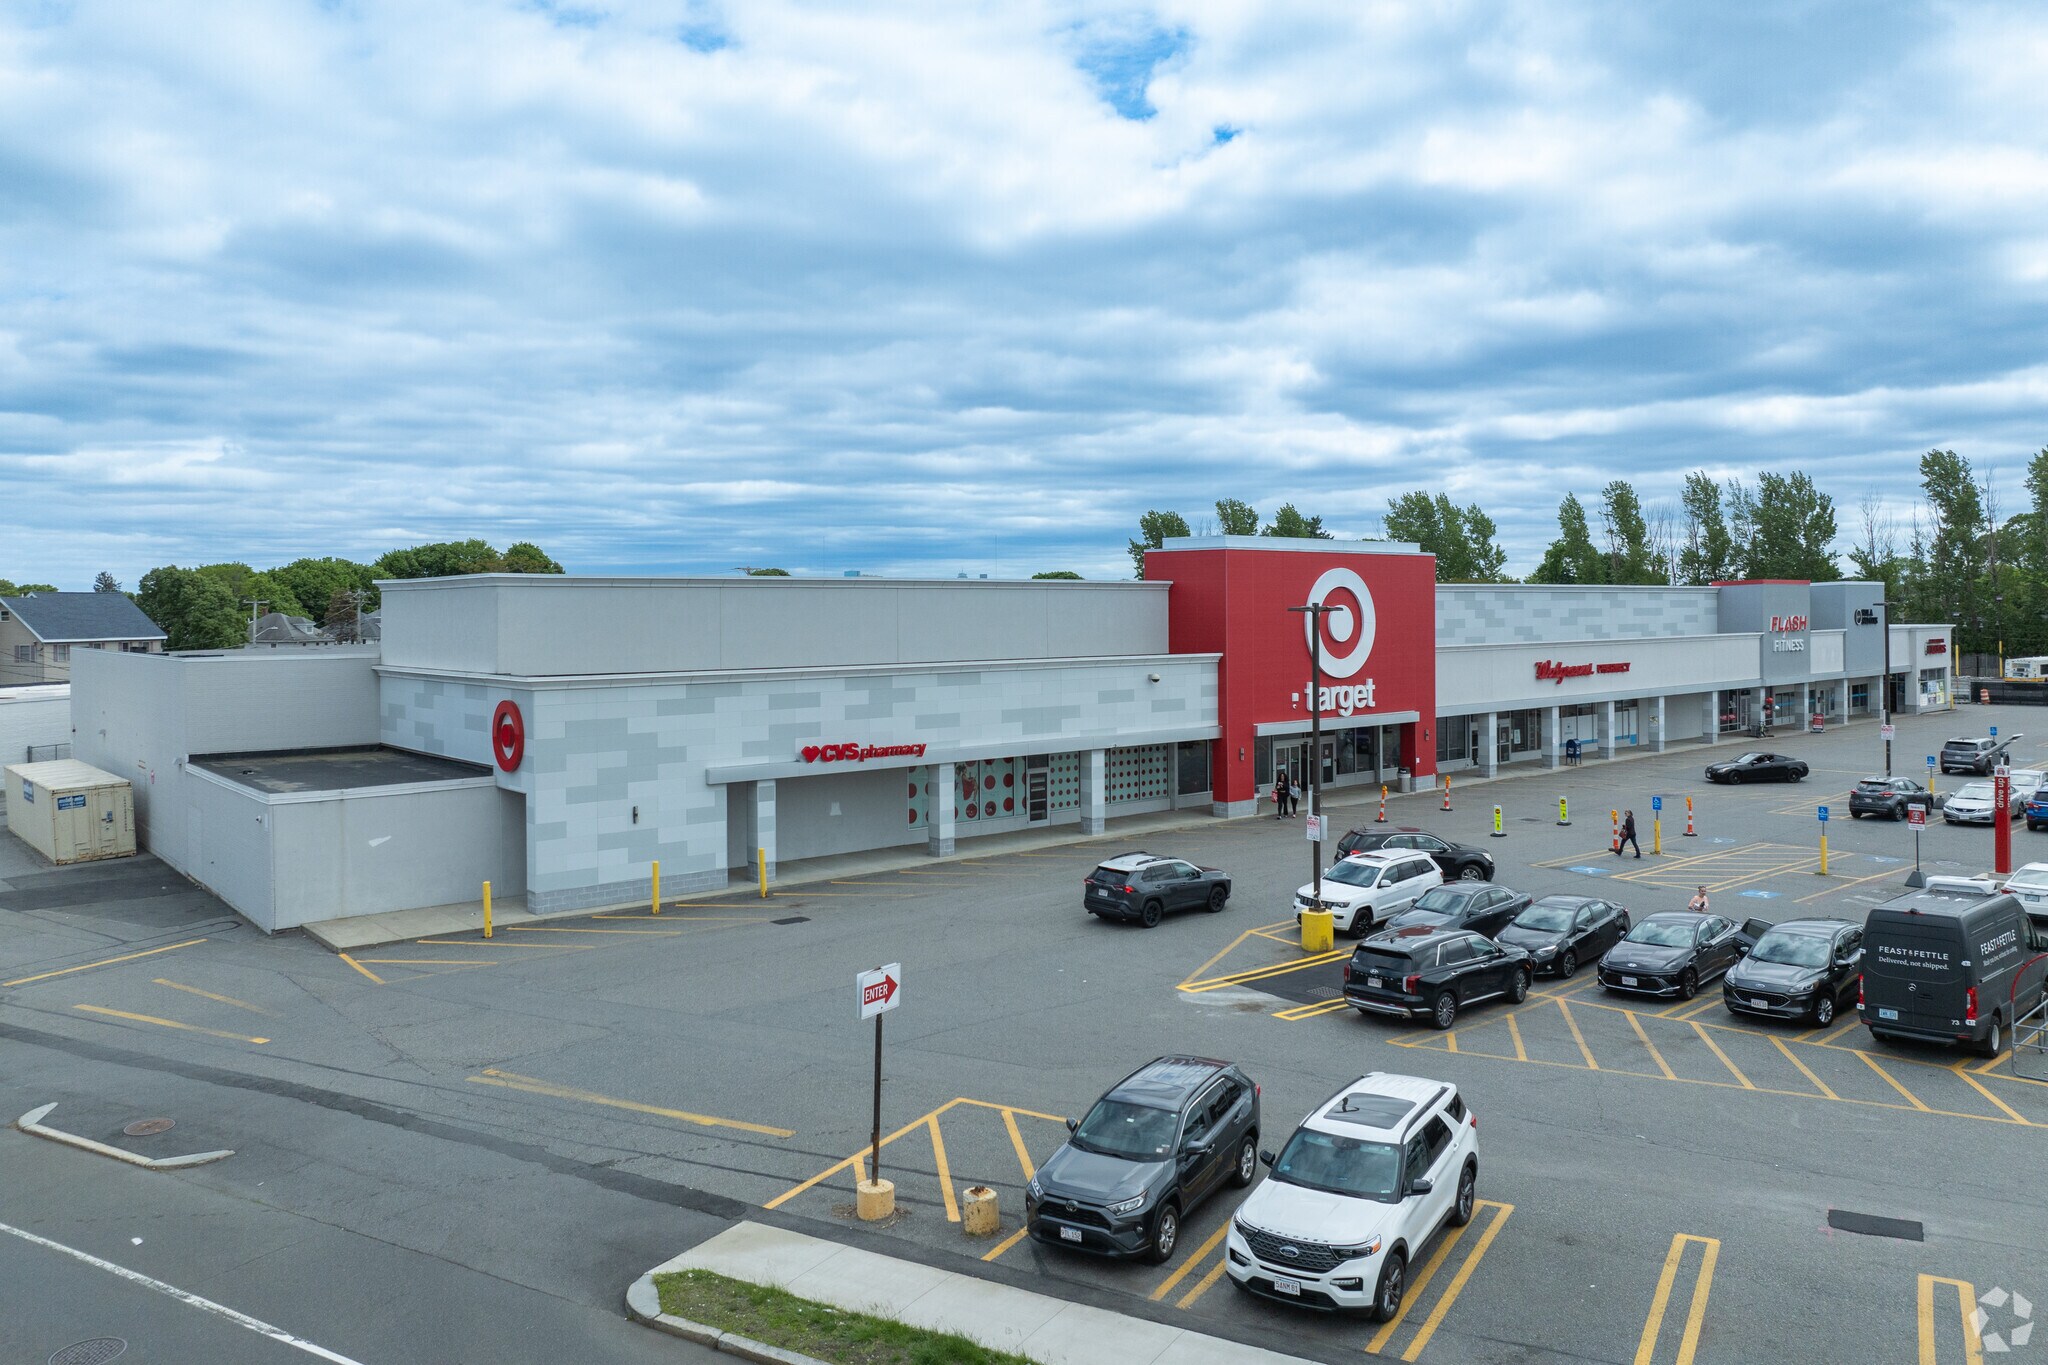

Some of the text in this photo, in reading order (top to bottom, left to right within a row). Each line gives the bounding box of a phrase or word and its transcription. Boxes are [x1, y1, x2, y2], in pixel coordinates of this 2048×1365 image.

[1771, 615, 1807, 633] FLASH
[1773, 638, 1805, 652] FITNESS
[1535, 660, 1595, 685] Walgreens
[1304, 678, 1376, 717] target
[820, 742, 927, 762] CVS pharmacy
[1997, 778, 2006, 808] drive up
[1878, 956, 1909, 967] Delivered,
[1922, 961, 1950, 971] shipped.
[865, 983, 889, 1002] ENTER
